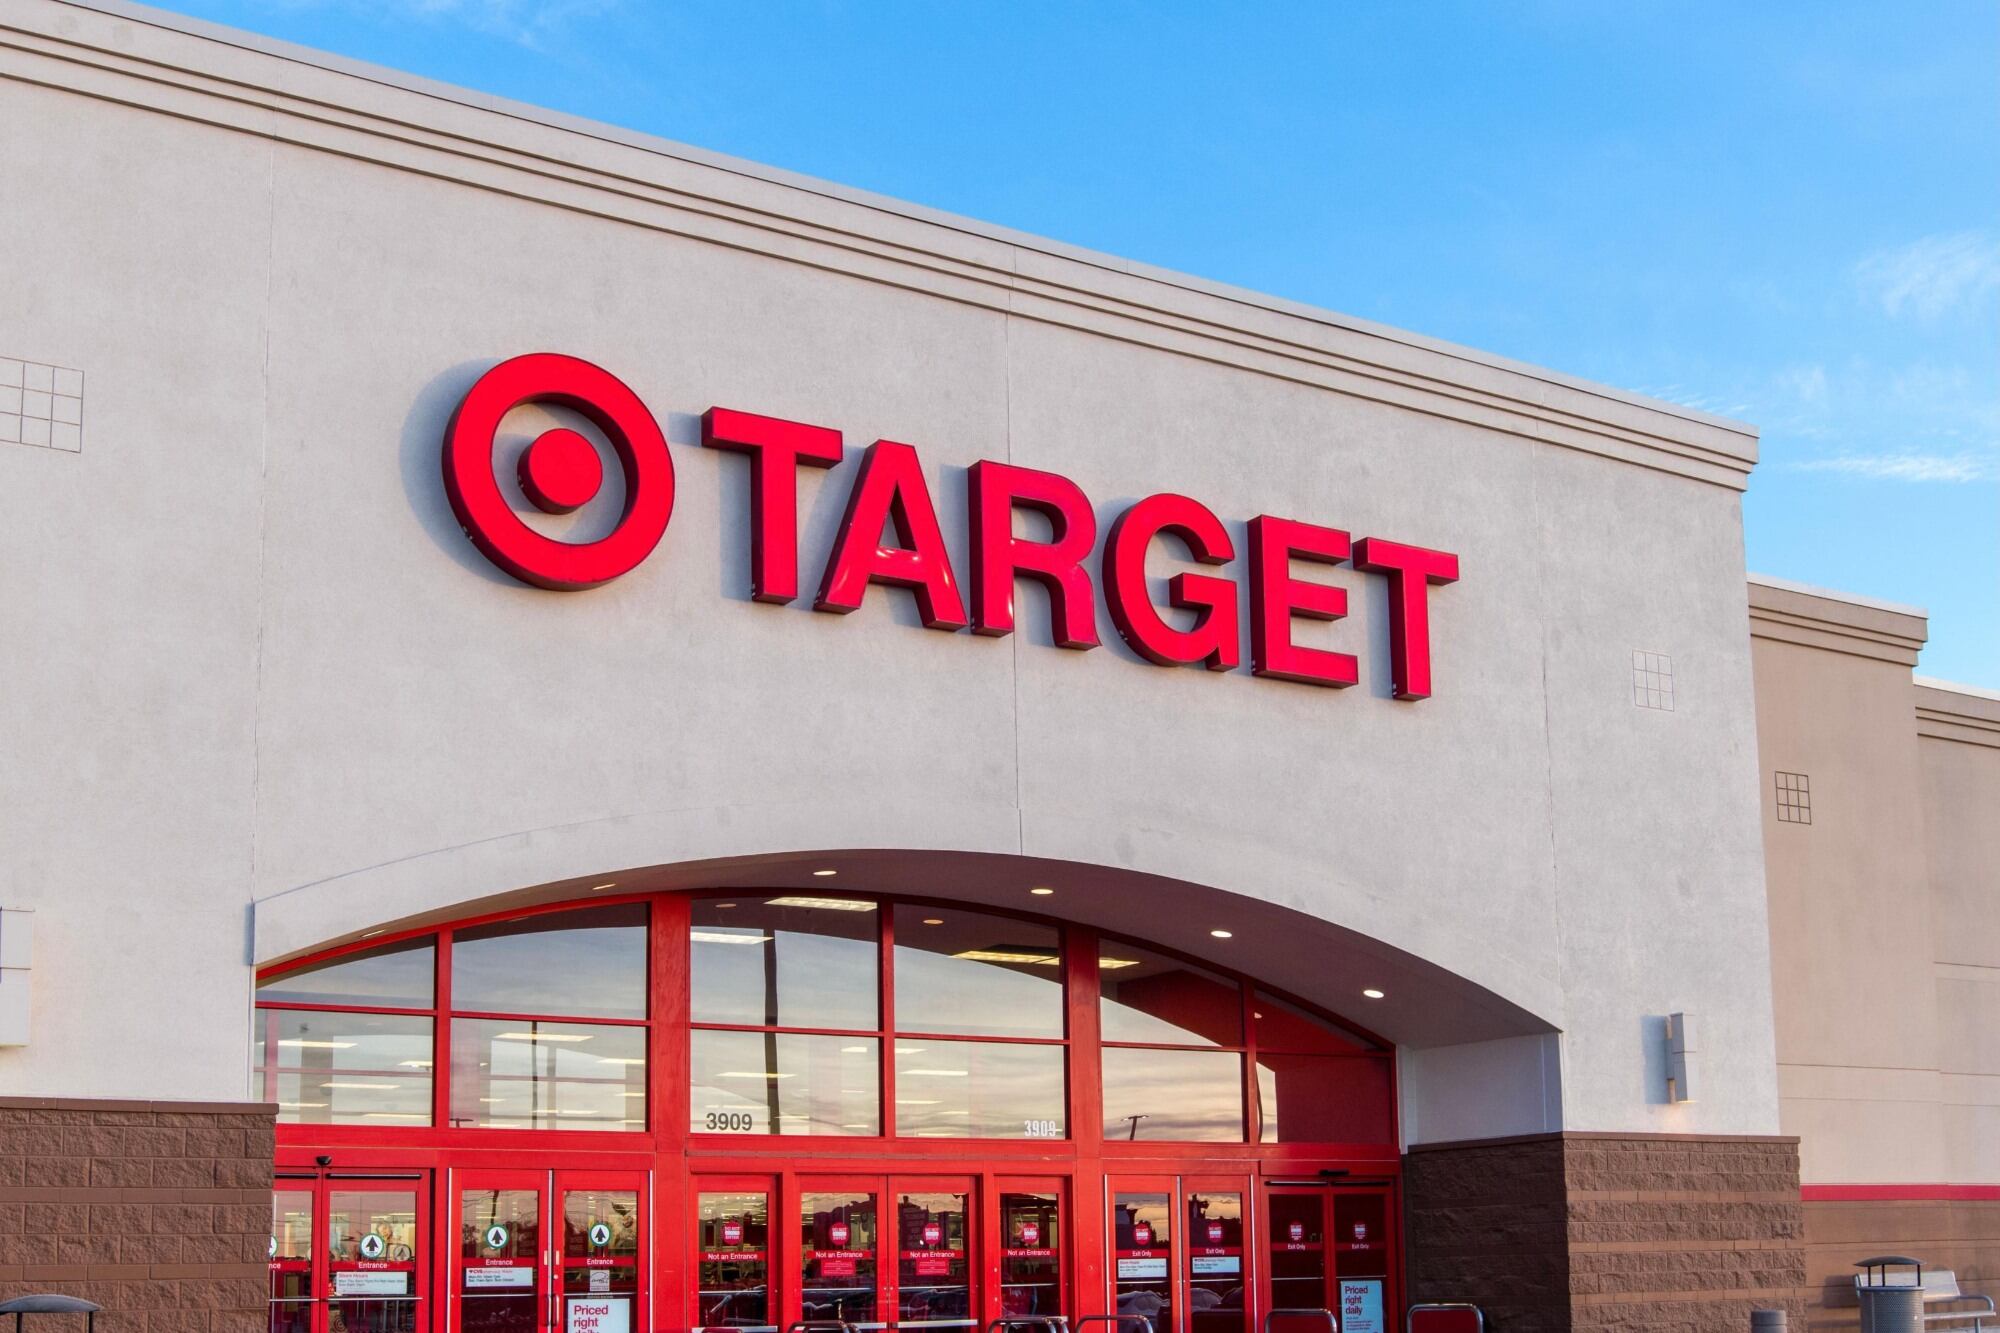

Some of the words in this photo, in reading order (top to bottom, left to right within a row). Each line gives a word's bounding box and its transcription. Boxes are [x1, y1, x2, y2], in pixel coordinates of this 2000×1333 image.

[701, 406, 1459, 701] TARGET
[706, 1112, 753, 1131] 3909
[1024, 1120, 1056, 1137] 3909
[707, 1252, 720, 1260] Not
[730, 1252, 758, 1260] Entrance
[1141, 1250, 1152, 1258] Only
[1214, 1248, 1225, 1256] Only
[358, 1261, 388, 1269] Entrance
[586, 1258, 614, 1266] Entrance
[1344, 1285, 1369, 1294] Priced
[1345, 1295, 1362, 1306] right
[573, 1304, 609, 1315] Priced
[1345, 1305, 1363, 1316] daily
[573, 1317, 599, 1330] right
